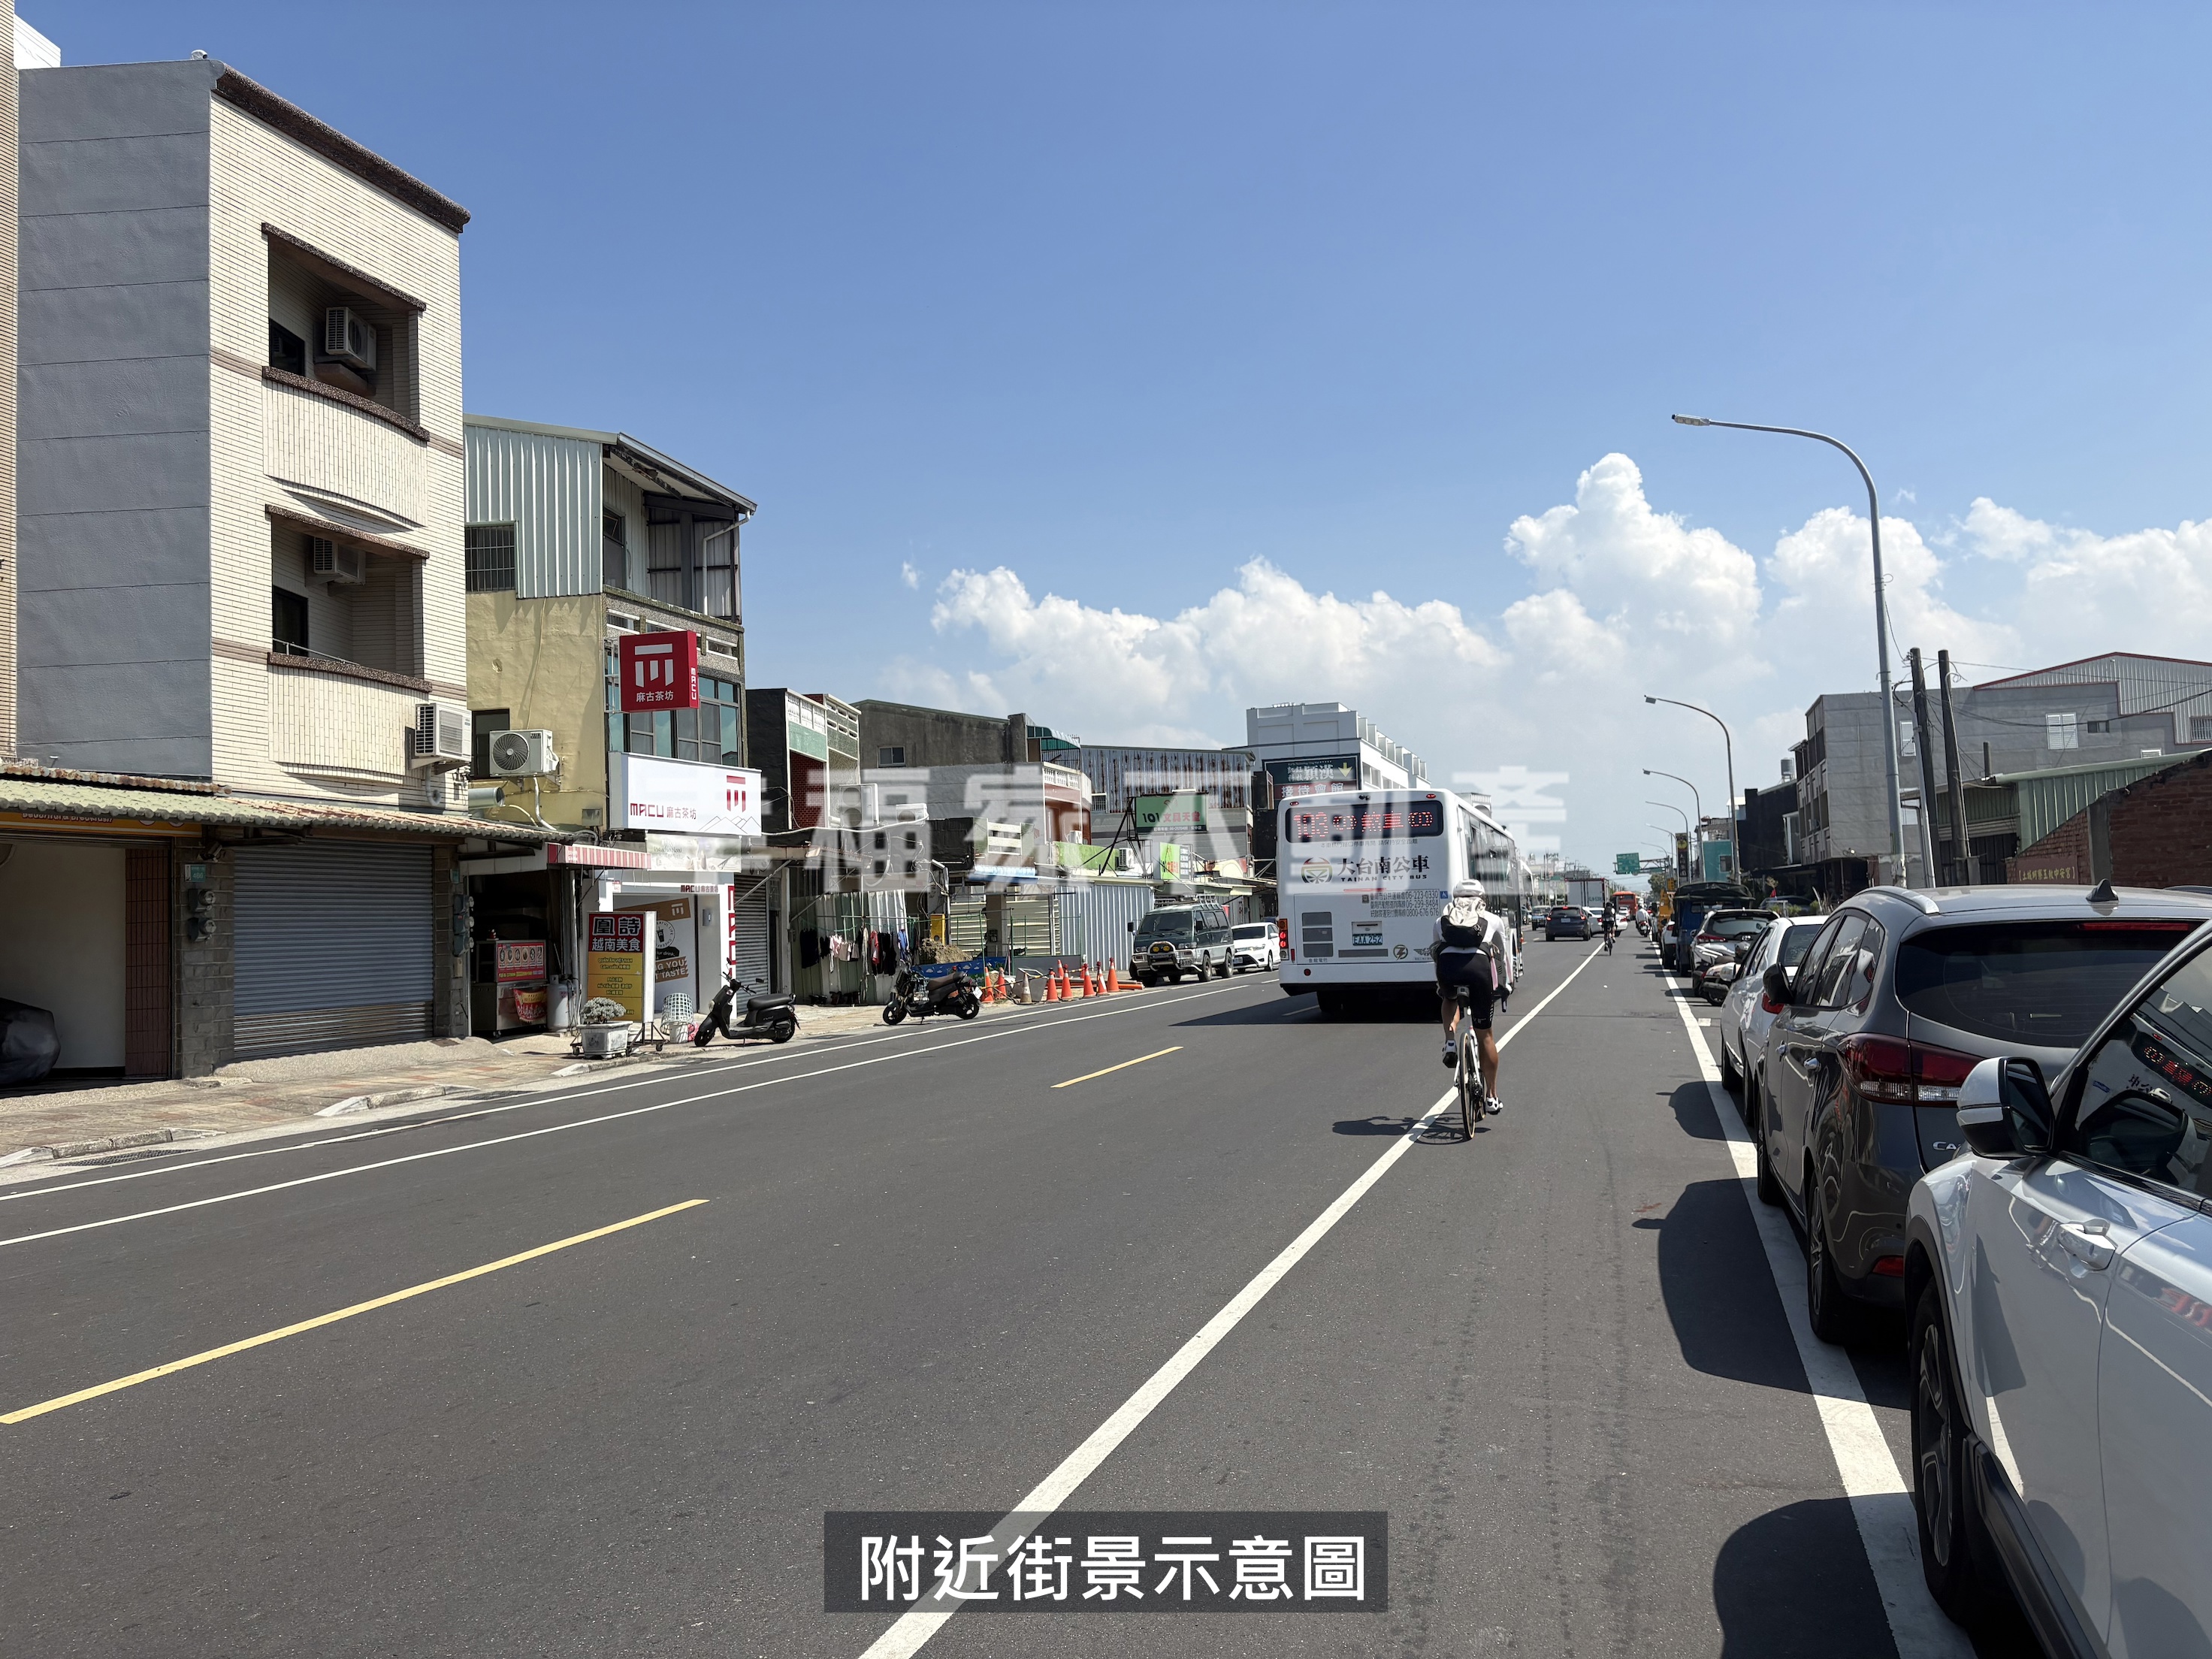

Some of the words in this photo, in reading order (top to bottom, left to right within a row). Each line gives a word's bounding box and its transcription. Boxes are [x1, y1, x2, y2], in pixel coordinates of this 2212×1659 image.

[636, 690, 674, 703] 麻古茶坊
[630, 802, 664, 817] MACU
[666, 805, 697, 820] 麻古茶坊
[1142, 812, 1161, 823] 101
[1163, 811, 1201, 823] 文具天堂
[1293, 811, 1328, 839] 103
[1337, 855, 1430, 876] 大台南公車
[592, 917, 642, 936] 凰詩
[592, 938, 641, 952] 越南美食
[1932, 1141, 1960, 1151] CA
